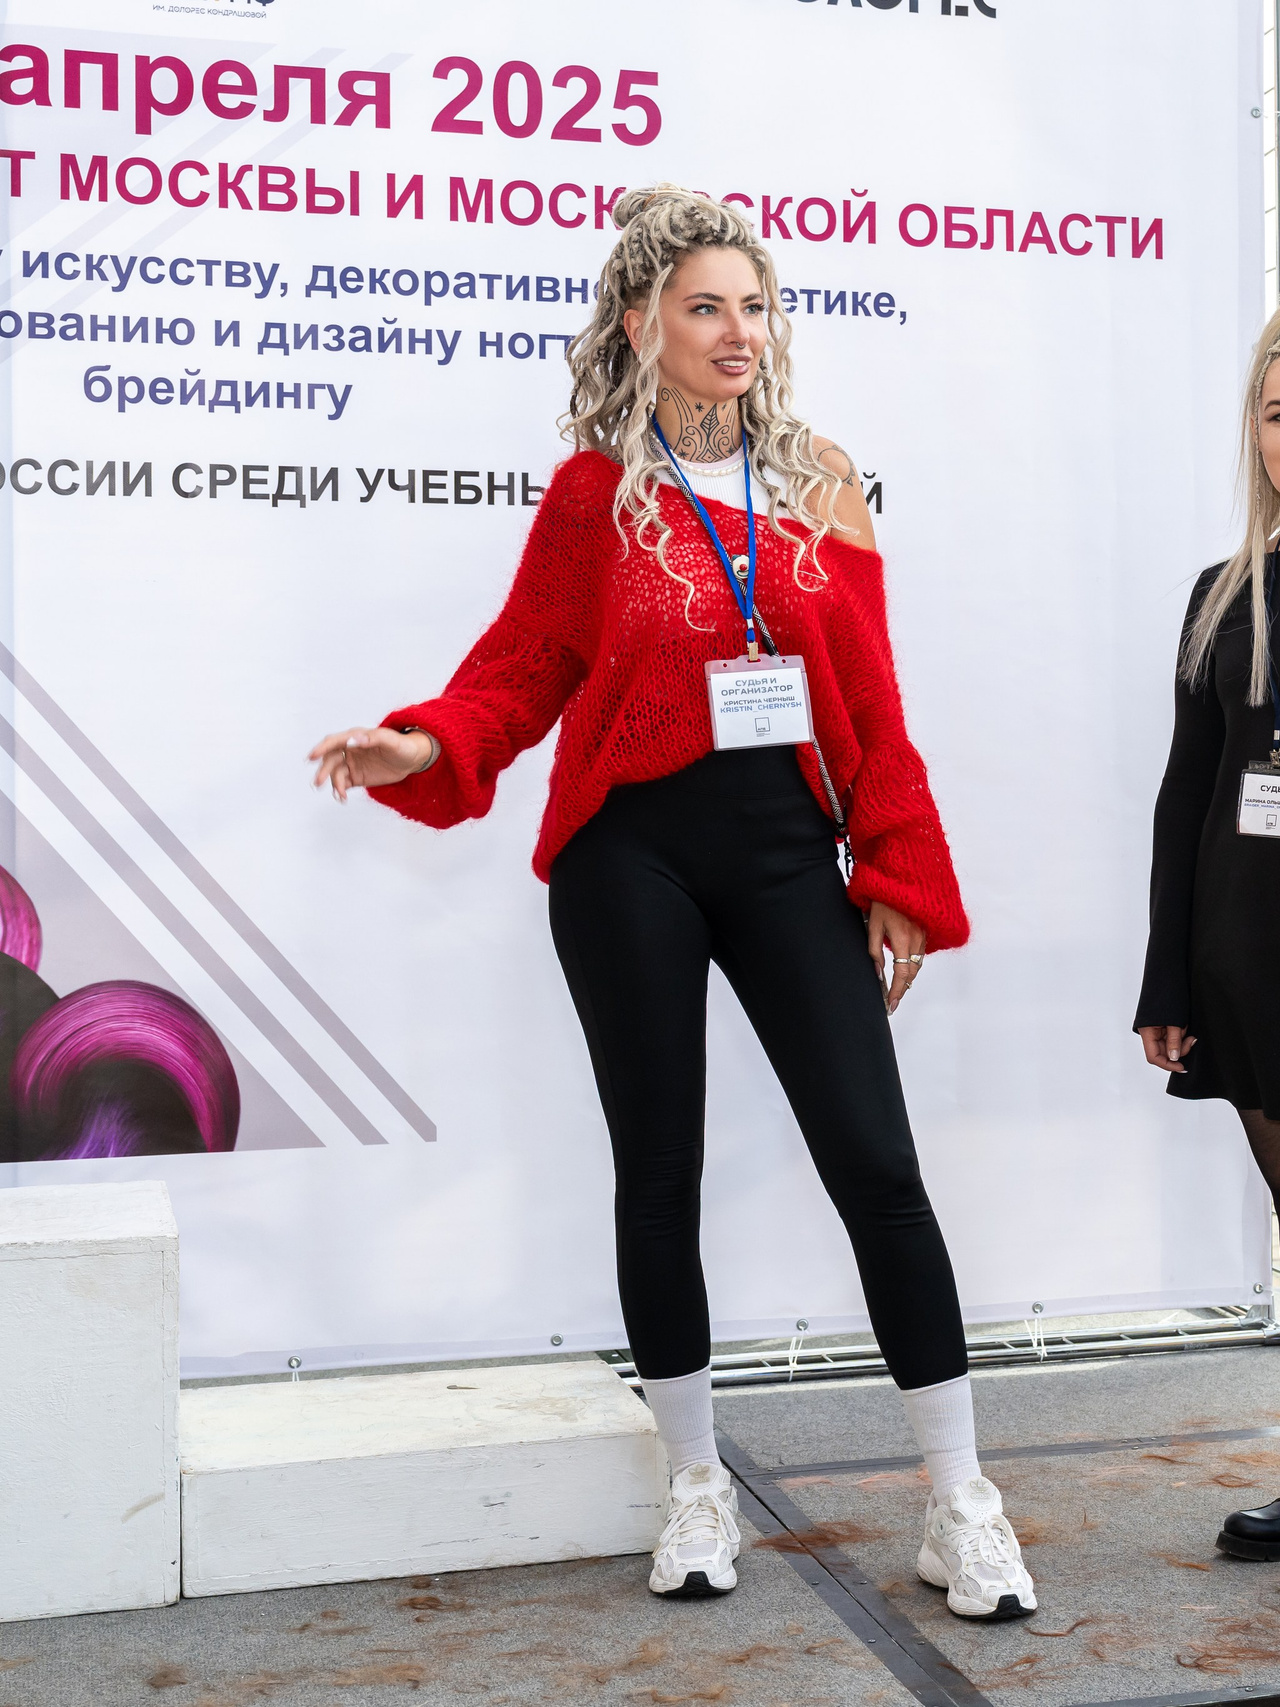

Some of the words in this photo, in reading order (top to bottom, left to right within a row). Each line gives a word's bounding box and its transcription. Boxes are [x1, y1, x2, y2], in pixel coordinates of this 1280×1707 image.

[0, 43, 391, 136] апреля
[430, 55, 662, 147] 2025
[60, 152, 360, 217] МОСКВЫ
[386, 172, 424, 220] И
[449, 176, 877, 245] МОСККОЙ
[898, 203, 1164, 260] ОБЛАСТИ
[22, 250, 288, 301] искусству,
[305, 264, 600, 306] декоративн
[214, 319, 241, 348] и
[257, 316, 462, 366] дизайну
[83, 364, 353, 421] брейдингу
[0, 457, 153, 498] ССИИ
[171, 462, 339, 509] СРЕДИ
[721, 684, 793, 697] ОРГАНИЗАТОР
[724, 698, 762, 706] КРИСТИНА
[763, 696, 795, 704] ЧЕРНЫШ
[735, 678, 768, 687] СУДЬЯ
